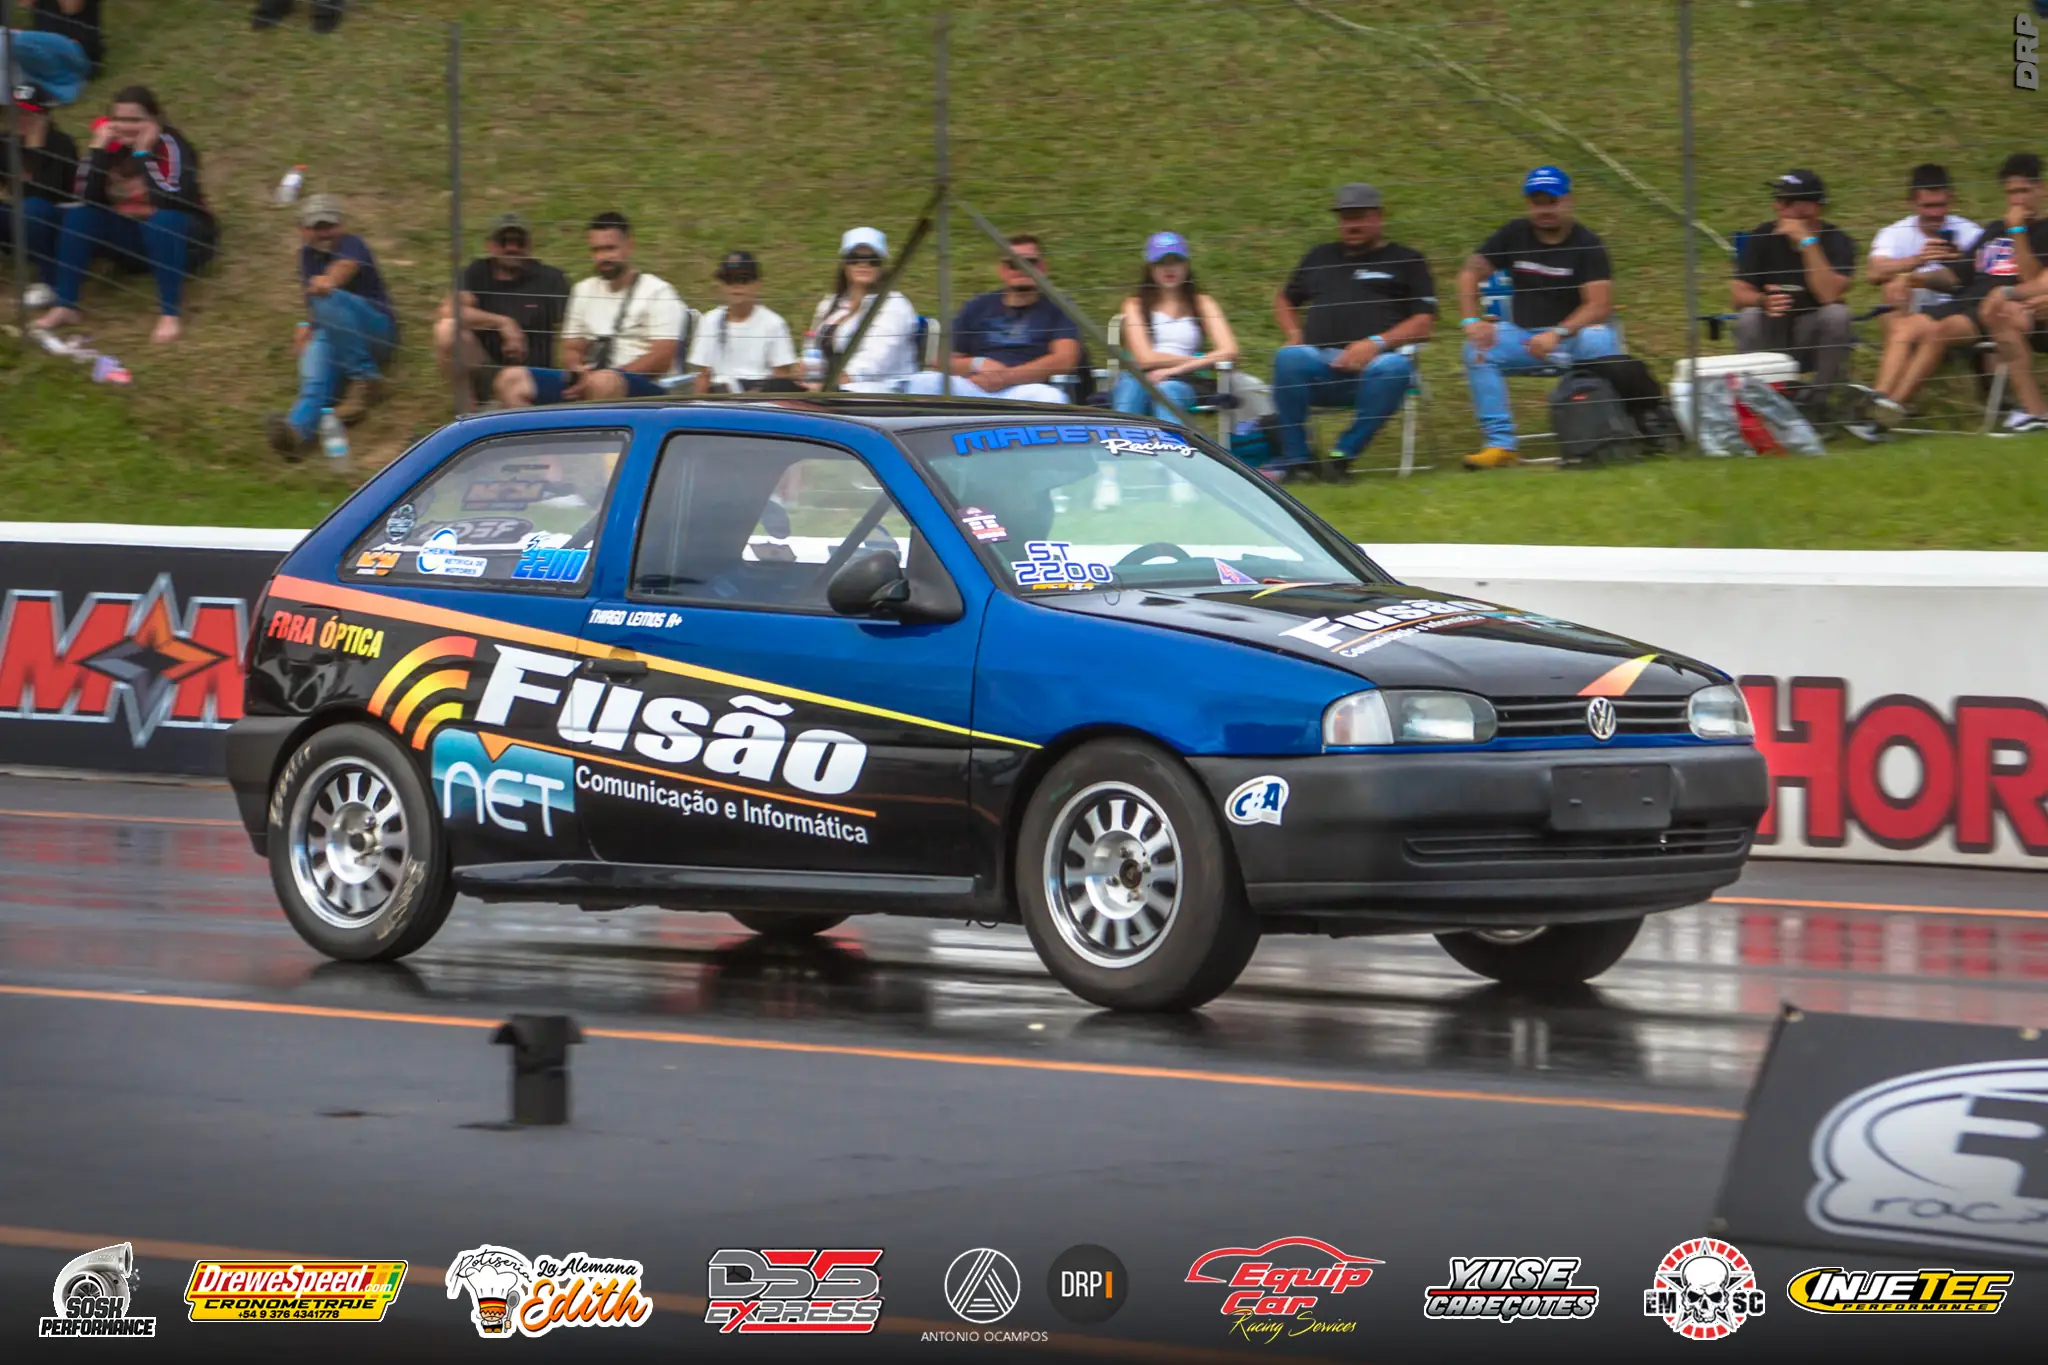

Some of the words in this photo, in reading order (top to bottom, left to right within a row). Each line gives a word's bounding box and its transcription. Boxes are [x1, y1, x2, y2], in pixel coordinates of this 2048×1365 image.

[1100, 438, 1198, 457] Racing
[511, 548, 591, 583] 2200
[1026, 543, 1070, 561] ST
[1013, 561, 1112, 584] 2200
[319, 615, 385, 659] ÓPTICA
[474, 643, 868, 795] Fusão
[575, 765, 719, 816] Comunicação
[724, 802, 738, 819] e
[743, 799, 869, 844] Informática
